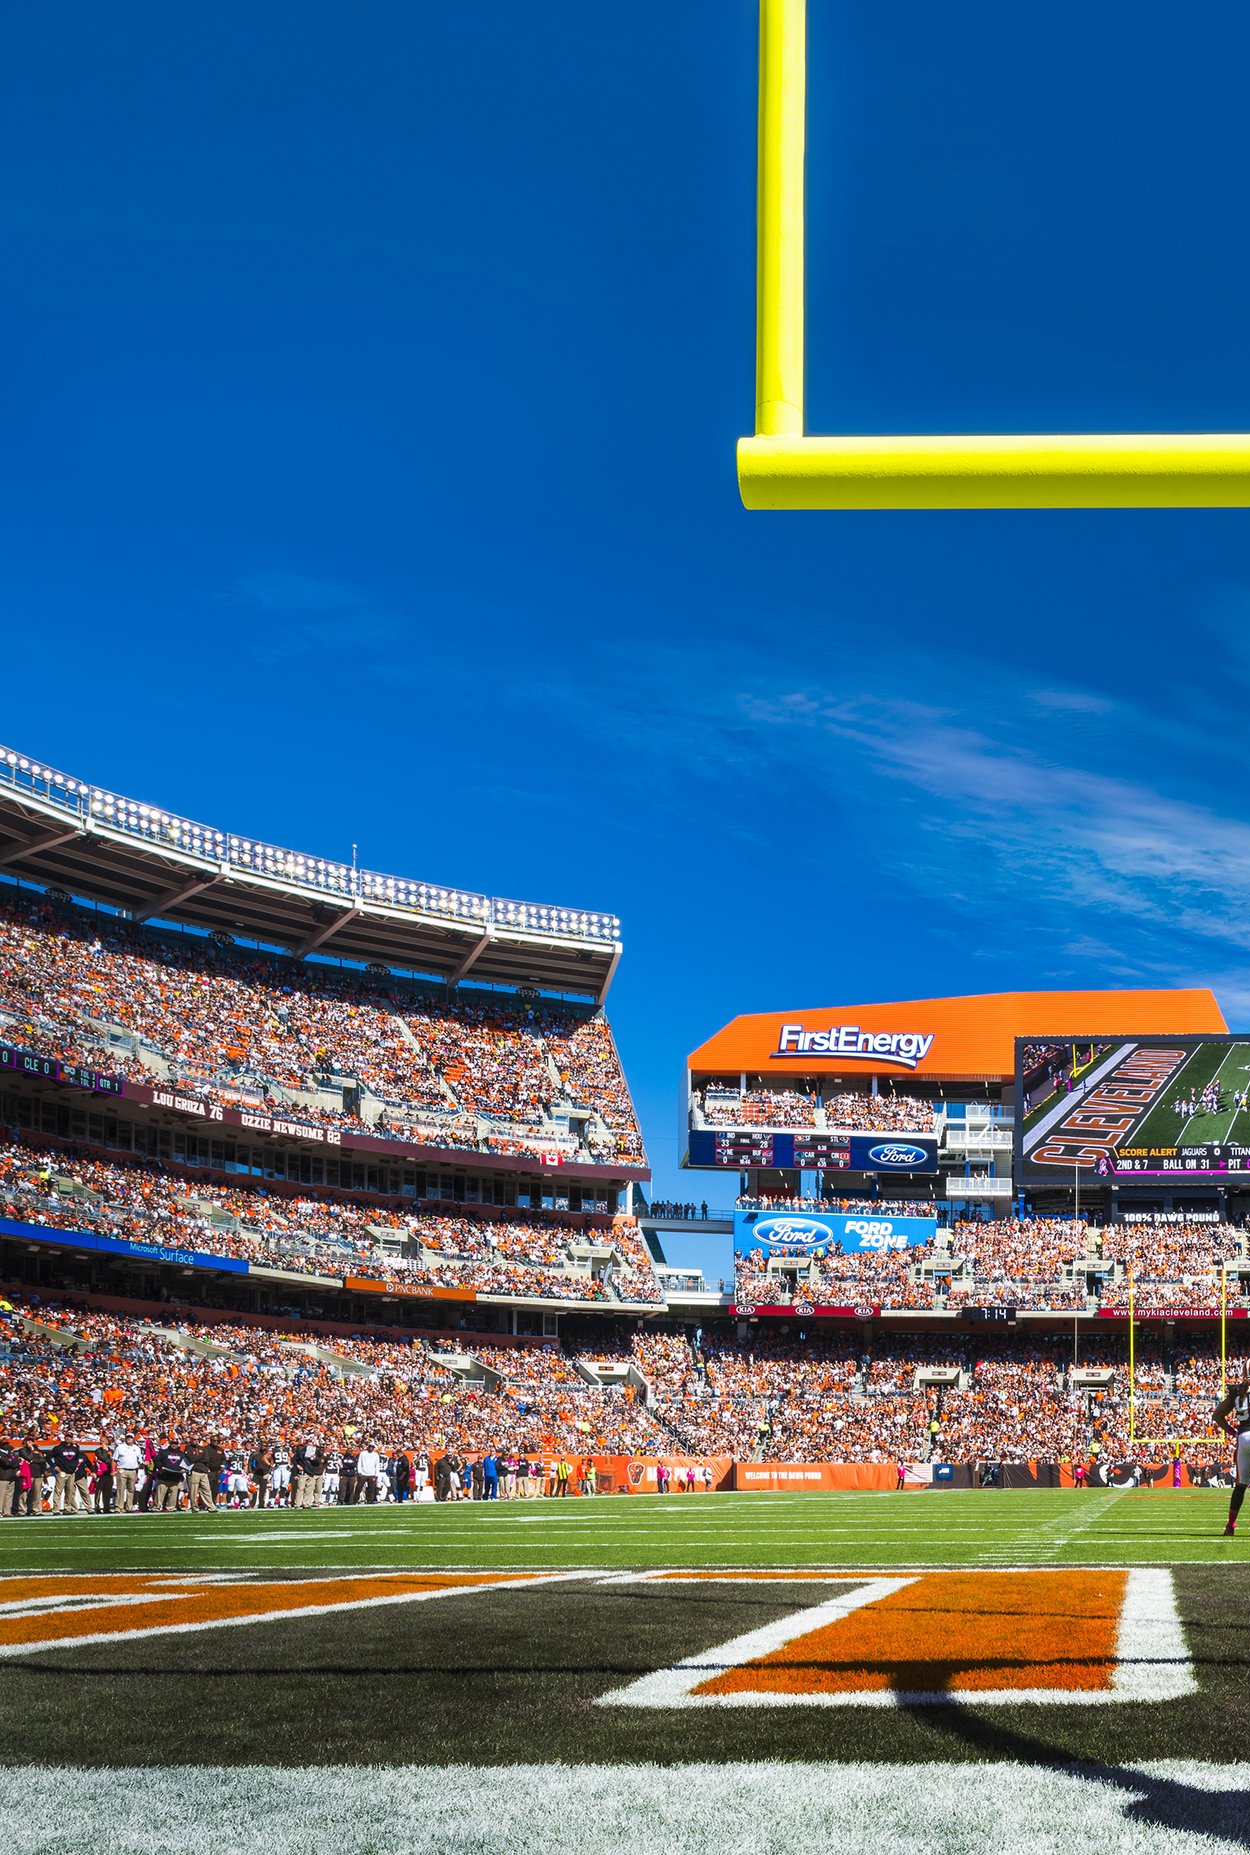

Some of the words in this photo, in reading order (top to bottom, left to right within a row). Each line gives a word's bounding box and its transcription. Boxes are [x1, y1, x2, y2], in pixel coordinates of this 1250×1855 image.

[779, 1025, 935, 1060] FirstEnergy
[25, 1057, 38, 1071] CLE
[44, 1063, 49, 1073] 0
[100, 1079, 110, 1089] QTR
[115, 1083, 118, 1091] 1
[153, 1091, 173, 1108] LOU
[175, 1097, 205, 1116] GROZA
[209, 1104, 223, 1121] 76
[1030, 1049, 1187, 1167] CLEVELAND
[241, 1113, 271, 1131] OZZIE
[273, 1121, 324, 1141] NEWSOME
[327, 1131, 341, 1145] 82
[879, 1147, 915, 1162] Ford
[1119, 1149, 1148, 1157] SCORE
[1181, 1147, 1207, 1156] JAGUARS
[1214, 1147, 1221, 1155] 0
[723, 1156, 727, 1164] 0
[1116, 1159, 1132, 1169] 2ND
[1134, 1159, 1141, 1169] &
[1143, 1159, 1149, 1169] 7
[1163, 1159, 1183, 1169] BALL
[1186, 1159, 1197, 1169] ON
[1201, 1159, 1210, 1169] 31
[1228, 1159, 1241, 1169] PIT
[1124, 1214, 1152, 1222] 100%
[1154, 1213, 1184, 1222] DAWG
[1186, 1213, 1220, 1222] POUND
[769, 1221, 817, 1243] Ford
[845, 1221, 893, 1235] FORD
[859, 1234, 908, 1249] ZONE
[130, 1243, 158, 1254] Microsoft
[160, 1248, 194, 1264] Surface
[738, 1306, 753, 1314] KIA
[798, 1306, 812, 1315] KIA
[857, 1307, 872, 1315] KIA
[981, 1308, 1007, 1319] 7:14
[274, 1452, 289, 1462] 99
